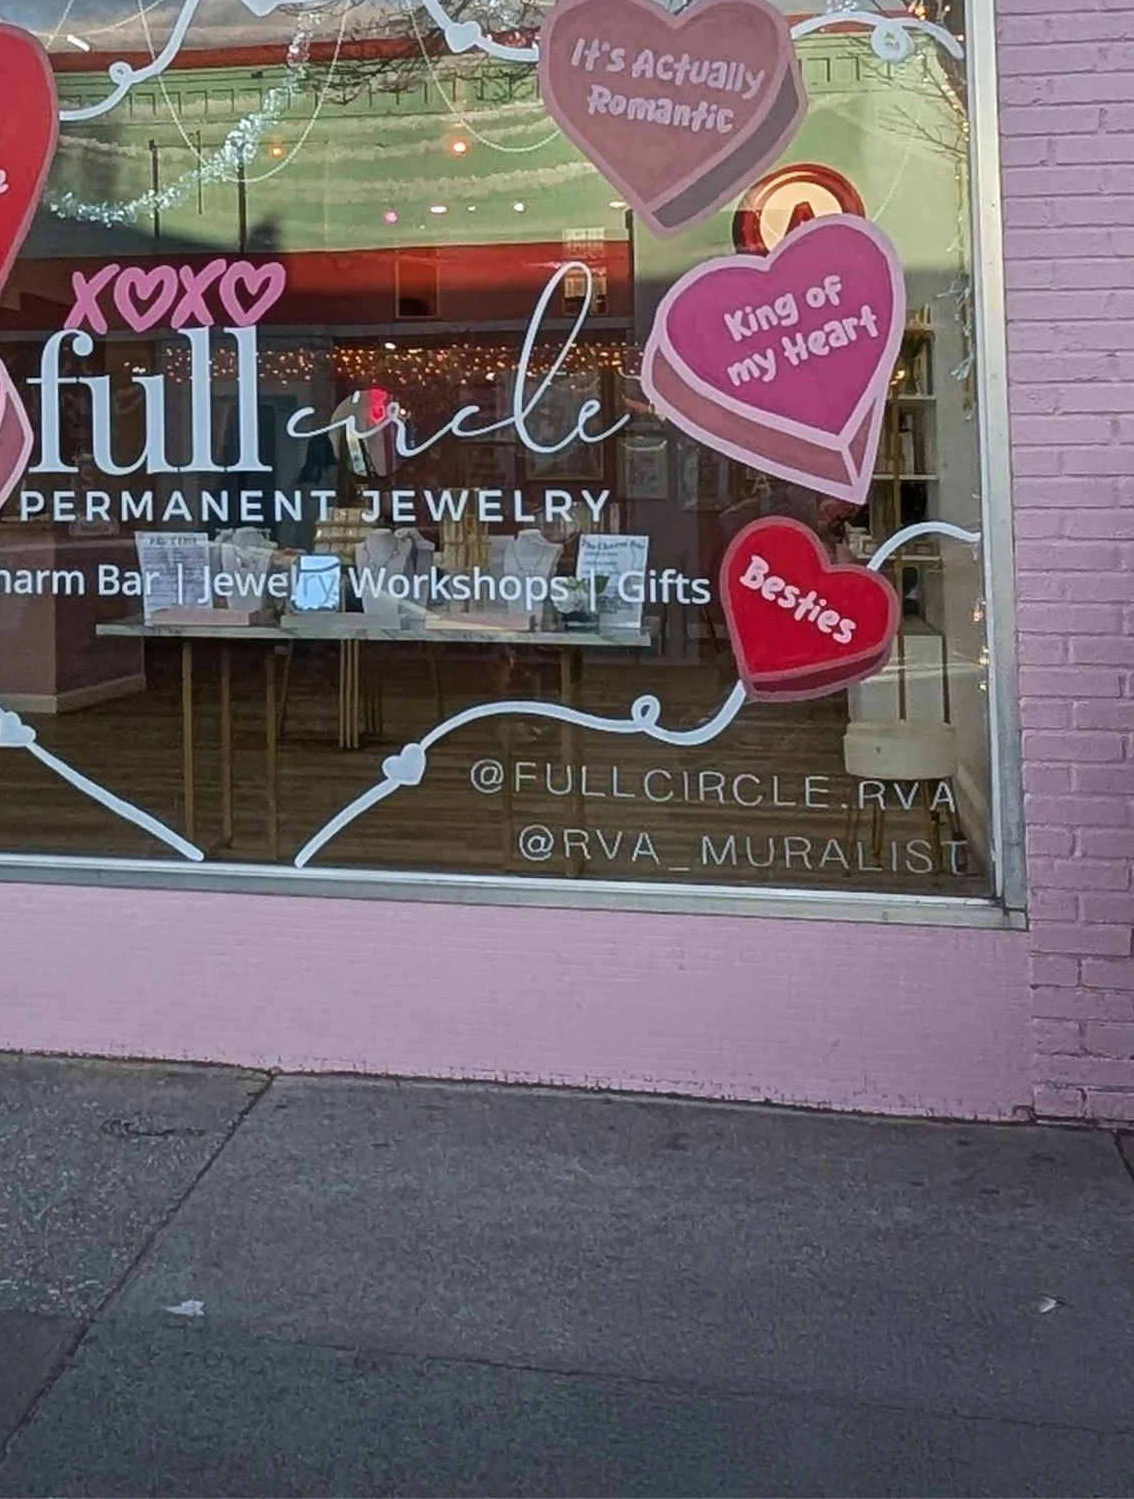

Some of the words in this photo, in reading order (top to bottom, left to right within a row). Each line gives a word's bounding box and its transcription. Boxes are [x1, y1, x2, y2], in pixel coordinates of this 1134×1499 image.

[570, 38, 625, 73] It's
[632, 48, 765, 99] Actually
[587, 84, 735, 134] Romantic
[724, 292, 799, 342] King
[806, 275, 843, 309] of
[27, 326, 273, 476] full
[286, 261, 631, 458] circle
[726, 347, 778, 388] my
[782, 305, 879, 367] Heart
[19, 489, 337, 523] PERMANENT
[361, 488, 612, 523] JEWELRY
[98, 562, 160, 598] Bar
[349, 566, 568, 610] Workshops
[618, 568, 711, 605] Gifts
[738, 554, 857, 645] Besties
[470, 758, 955, 814] @FULLCIRCLE.RVA
[518, 823, 968, 876] @RVA_MURALIST
